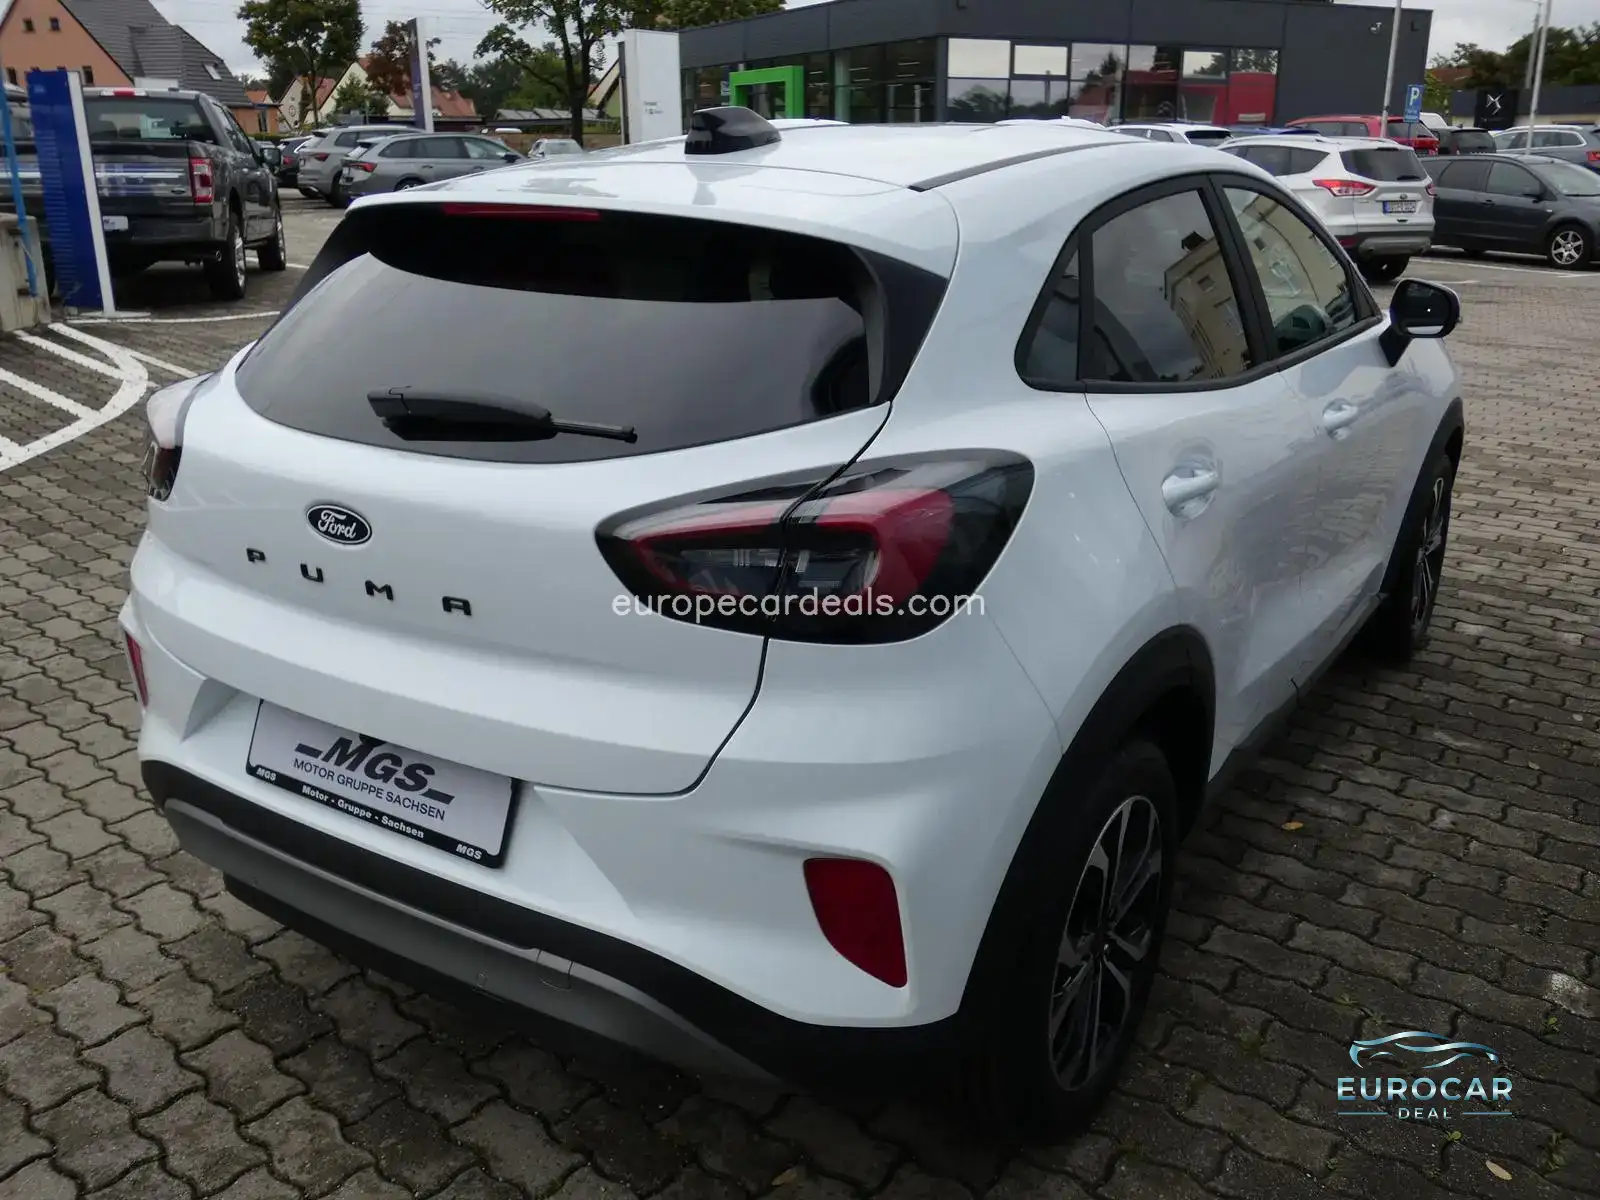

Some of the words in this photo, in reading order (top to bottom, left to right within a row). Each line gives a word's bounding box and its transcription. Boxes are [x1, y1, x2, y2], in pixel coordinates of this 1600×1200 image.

[1410, 87, 1420, 105] P
[318, 510, 356, 538] Ford
[246, 548, 472, 616] PUMA
[256, 767, 276, 781] MGS
[321, 735, 435, 792] MGS
[294, 758, 335, 781] MOTOR
[337, 774, 384, 799] GRUPPE
[386, 791, 445, 821] SACHSEN
[302, 785, 329, 802] Motor
[337, 799, 372, 819] Gruppe
[381, 815, 424, 839] Sachsen
[456, 844, 483, 860] MGS
